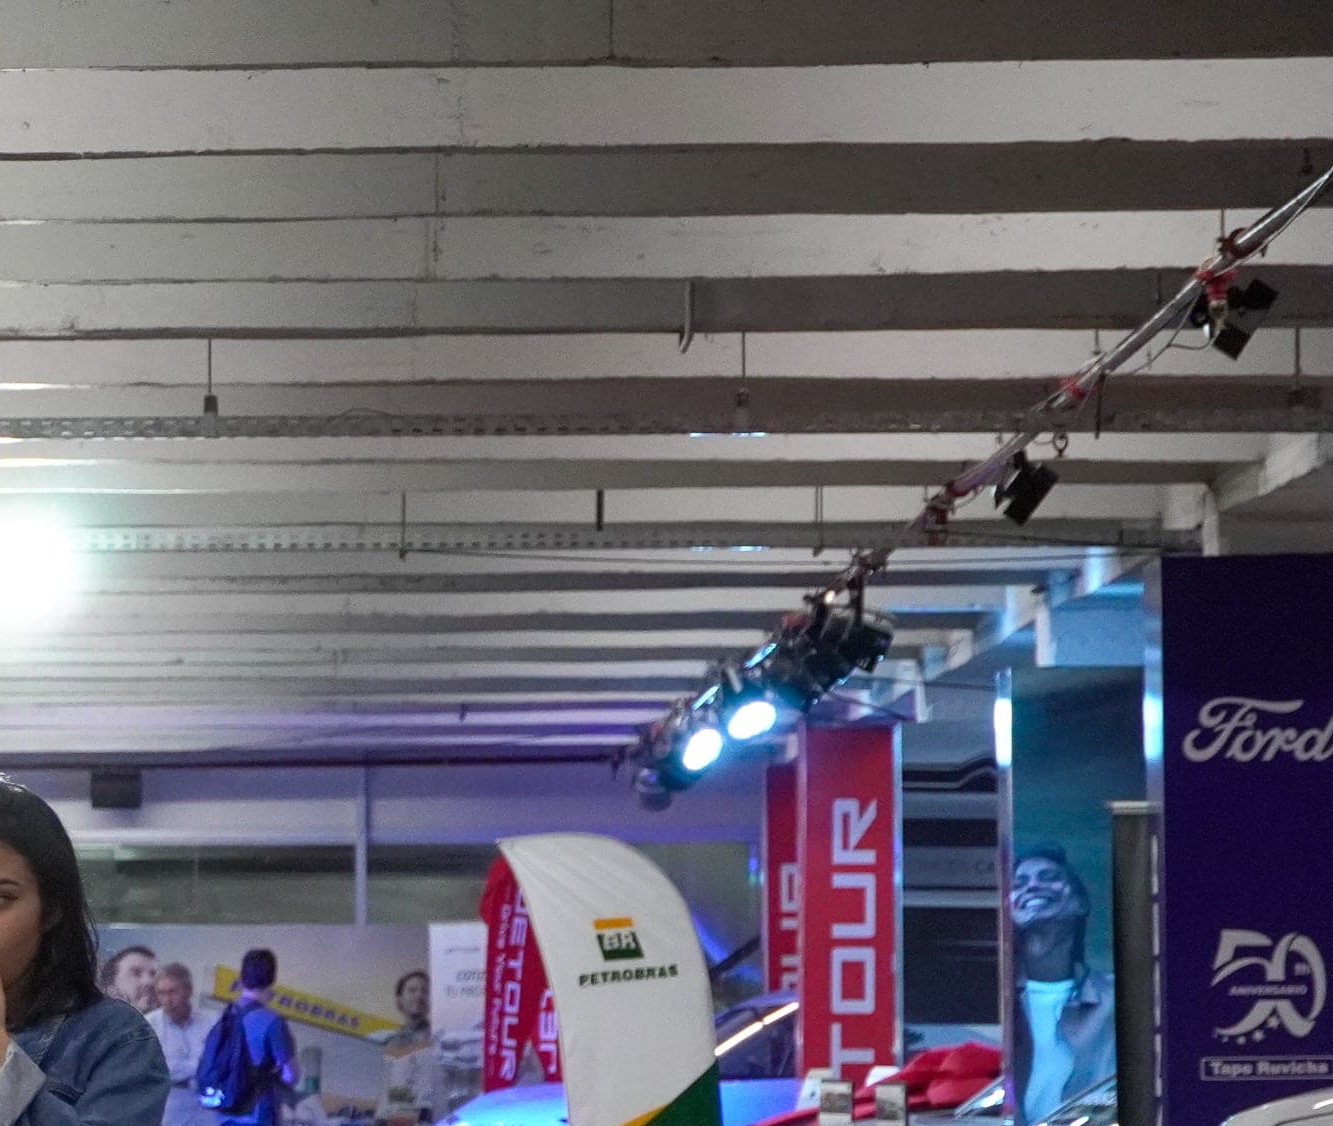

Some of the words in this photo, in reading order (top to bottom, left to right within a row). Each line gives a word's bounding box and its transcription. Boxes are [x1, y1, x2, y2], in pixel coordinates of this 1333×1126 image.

[1182, 696, 1333, 763] Ford
[831, 797, 877, 1078] TOUR
[578, 963, 679, 987] PETROBRAS
